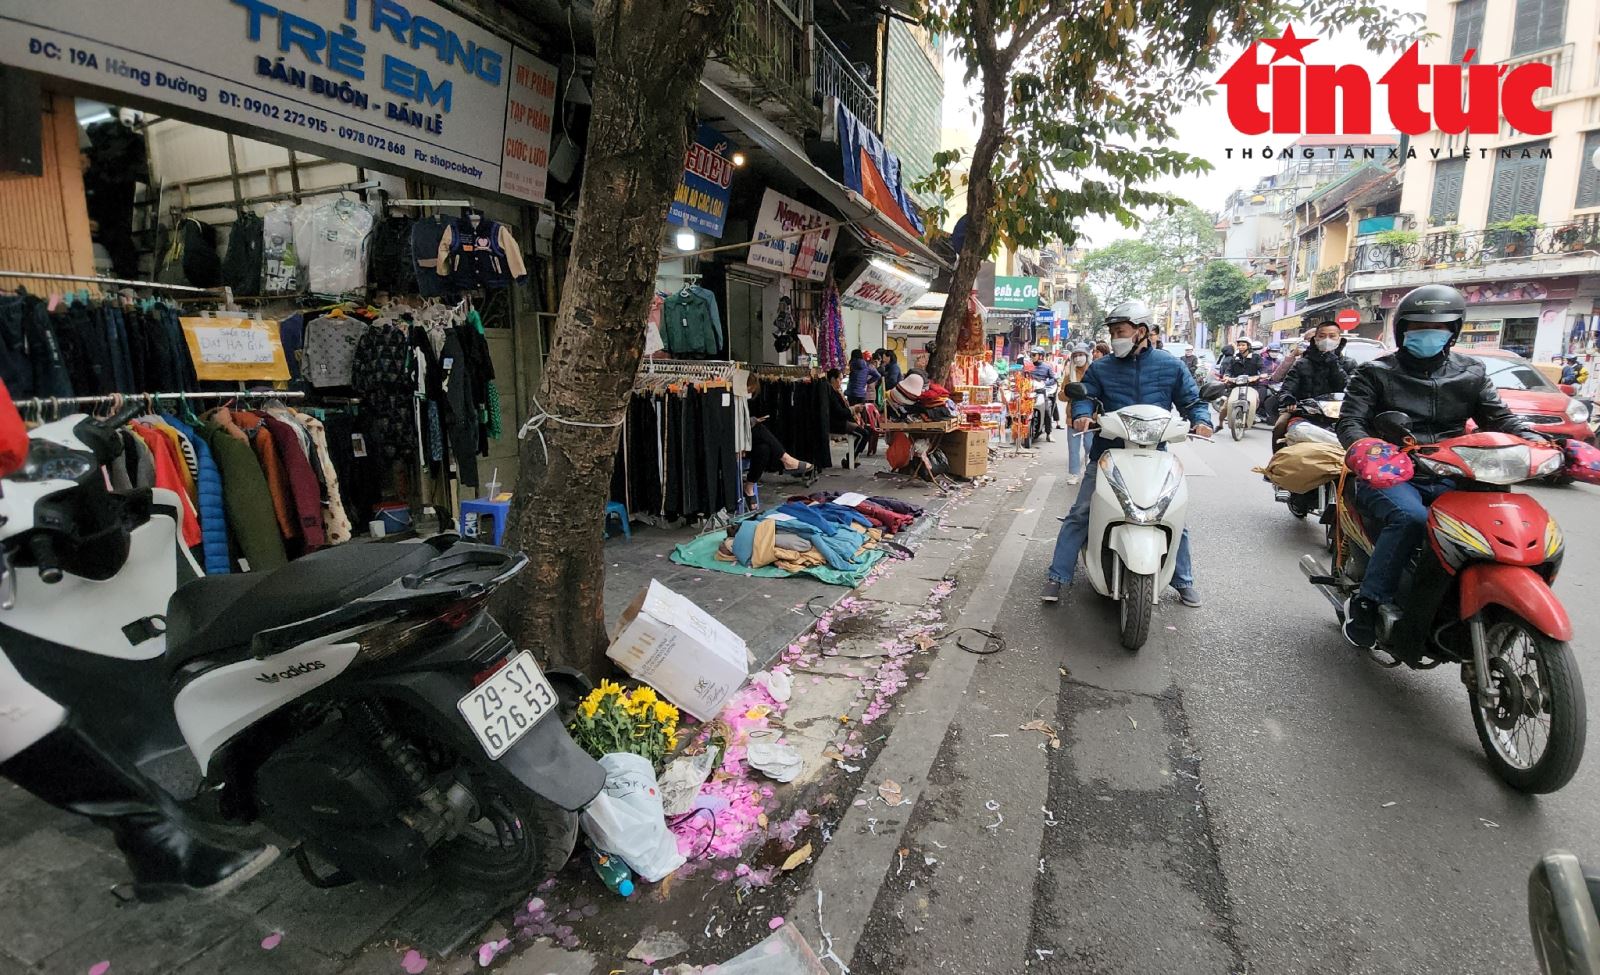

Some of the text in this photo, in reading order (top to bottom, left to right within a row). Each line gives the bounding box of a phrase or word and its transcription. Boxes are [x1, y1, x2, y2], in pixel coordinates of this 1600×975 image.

[29, 37, 61, 61] ĐC:
[69, 48, 98, 70] 19A
[105, 56, 151, 87] Hàng
[155, 72, 207, 102] Đường
[219, 89, 241, 108] ĐT:
[244, 97, 279, 119] 0902
[283, 109, 306, 126] 272
[307, 116, 328, 133] 915
[338, 126, 365, 143] 0978
[367, 134, 386, 150] 072
[387, 144, 406, 156] 868
[255, 55, 306, 89] BÁN
[309, 74, 369, 110] BUÔN
[385, 102, 424, 130] BÁN
[382, 54, 453, 113] EM
[279, 660, 326, 679] adidas
[474, 662, 532, 721] 29-S1
[484, 683, 551, 750] 626.53
